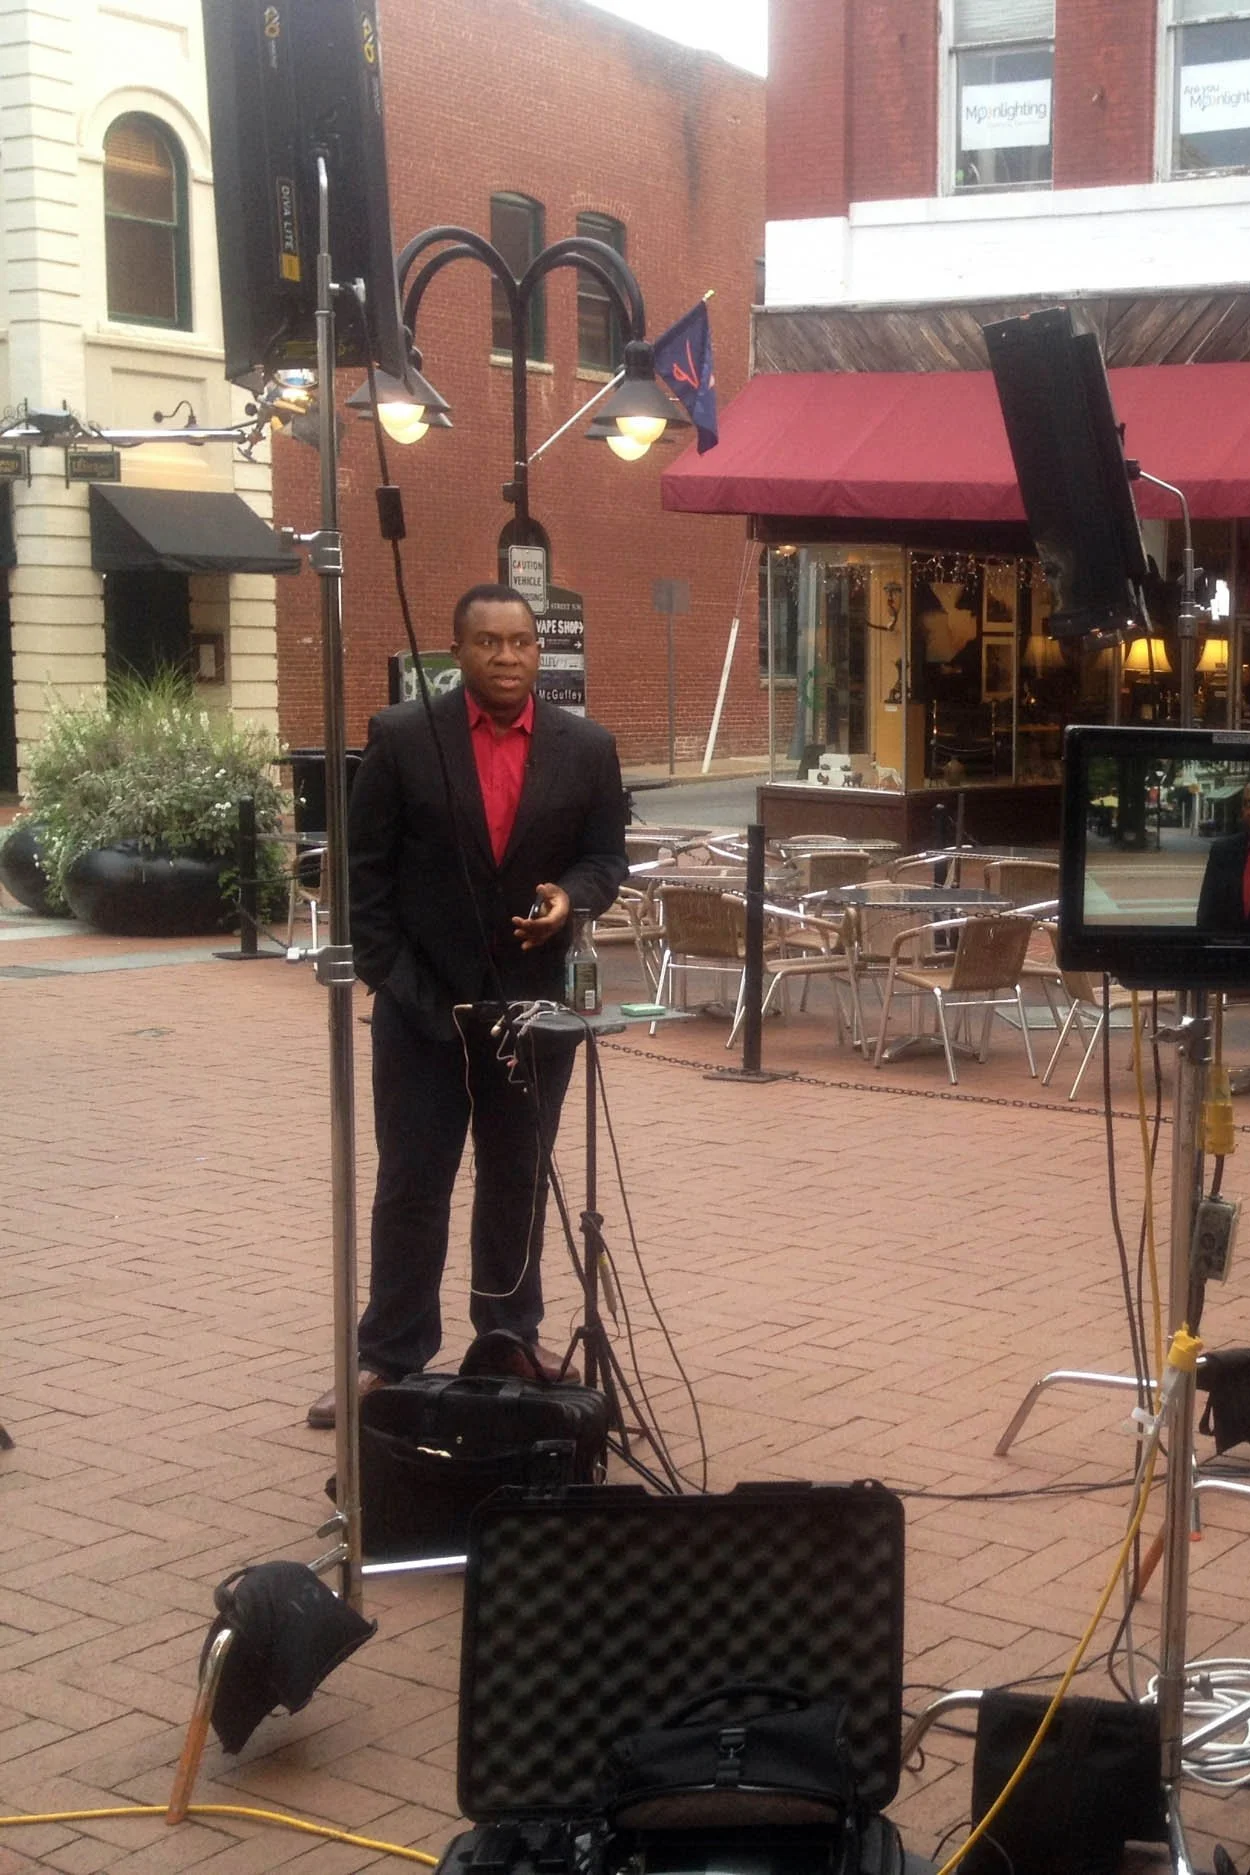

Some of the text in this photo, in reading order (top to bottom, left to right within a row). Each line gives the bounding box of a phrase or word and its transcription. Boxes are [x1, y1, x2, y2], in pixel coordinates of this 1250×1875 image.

[281, 185, 291, 216] DIVA
[284, 221, 294, 250] LITE
[512, 560, 543, 570] CAUTION
[513, 576, 542, 586] VEHICLE
[536, 620, 578, 634] VAPE SHOP
